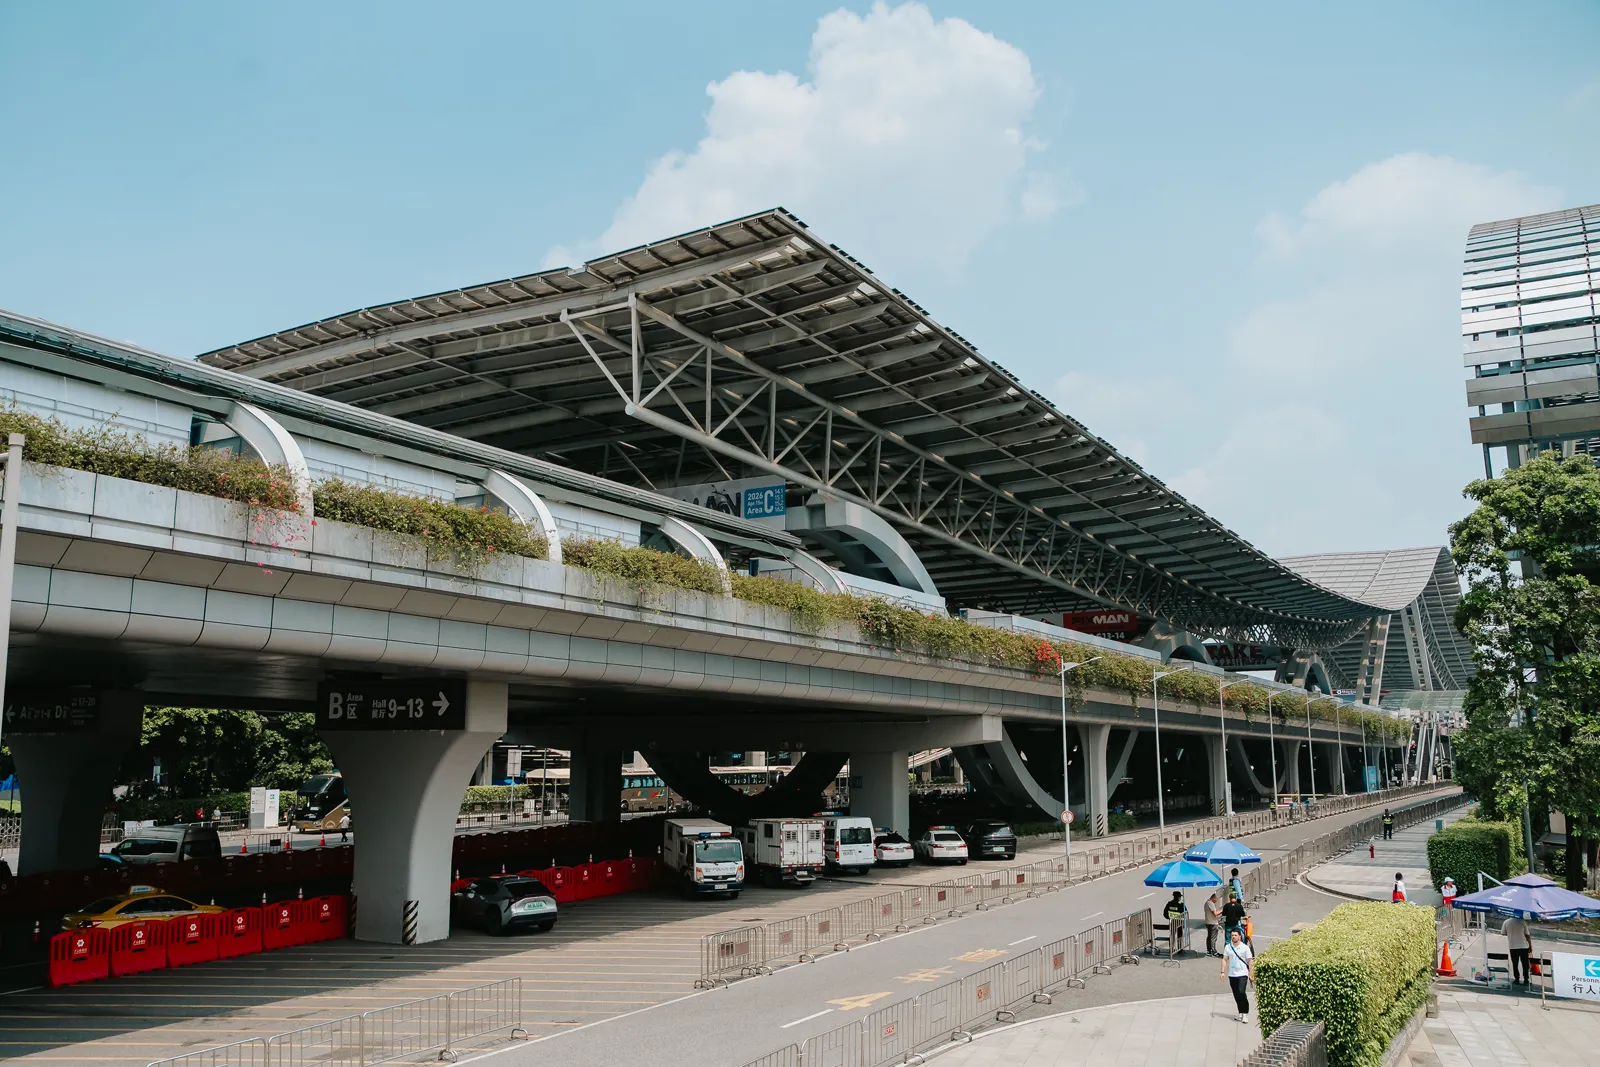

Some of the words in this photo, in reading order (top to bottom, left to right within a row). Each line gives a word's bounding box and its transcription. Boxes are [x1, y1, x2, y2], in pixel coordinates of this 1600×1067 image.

[747, 507, 763, 515] Area
[764, 490, 774, 514] C
[748, 492, 763, 501] 2026
[328, 692, 344, 719] B
[347, 692, 363, 702] Area
[347, 703, 358, 719] 区
[372, 699, 387, 709] Hall
[387, 698, 424, 719] 9-13
[1573, 983, 1600, 995] 行人
